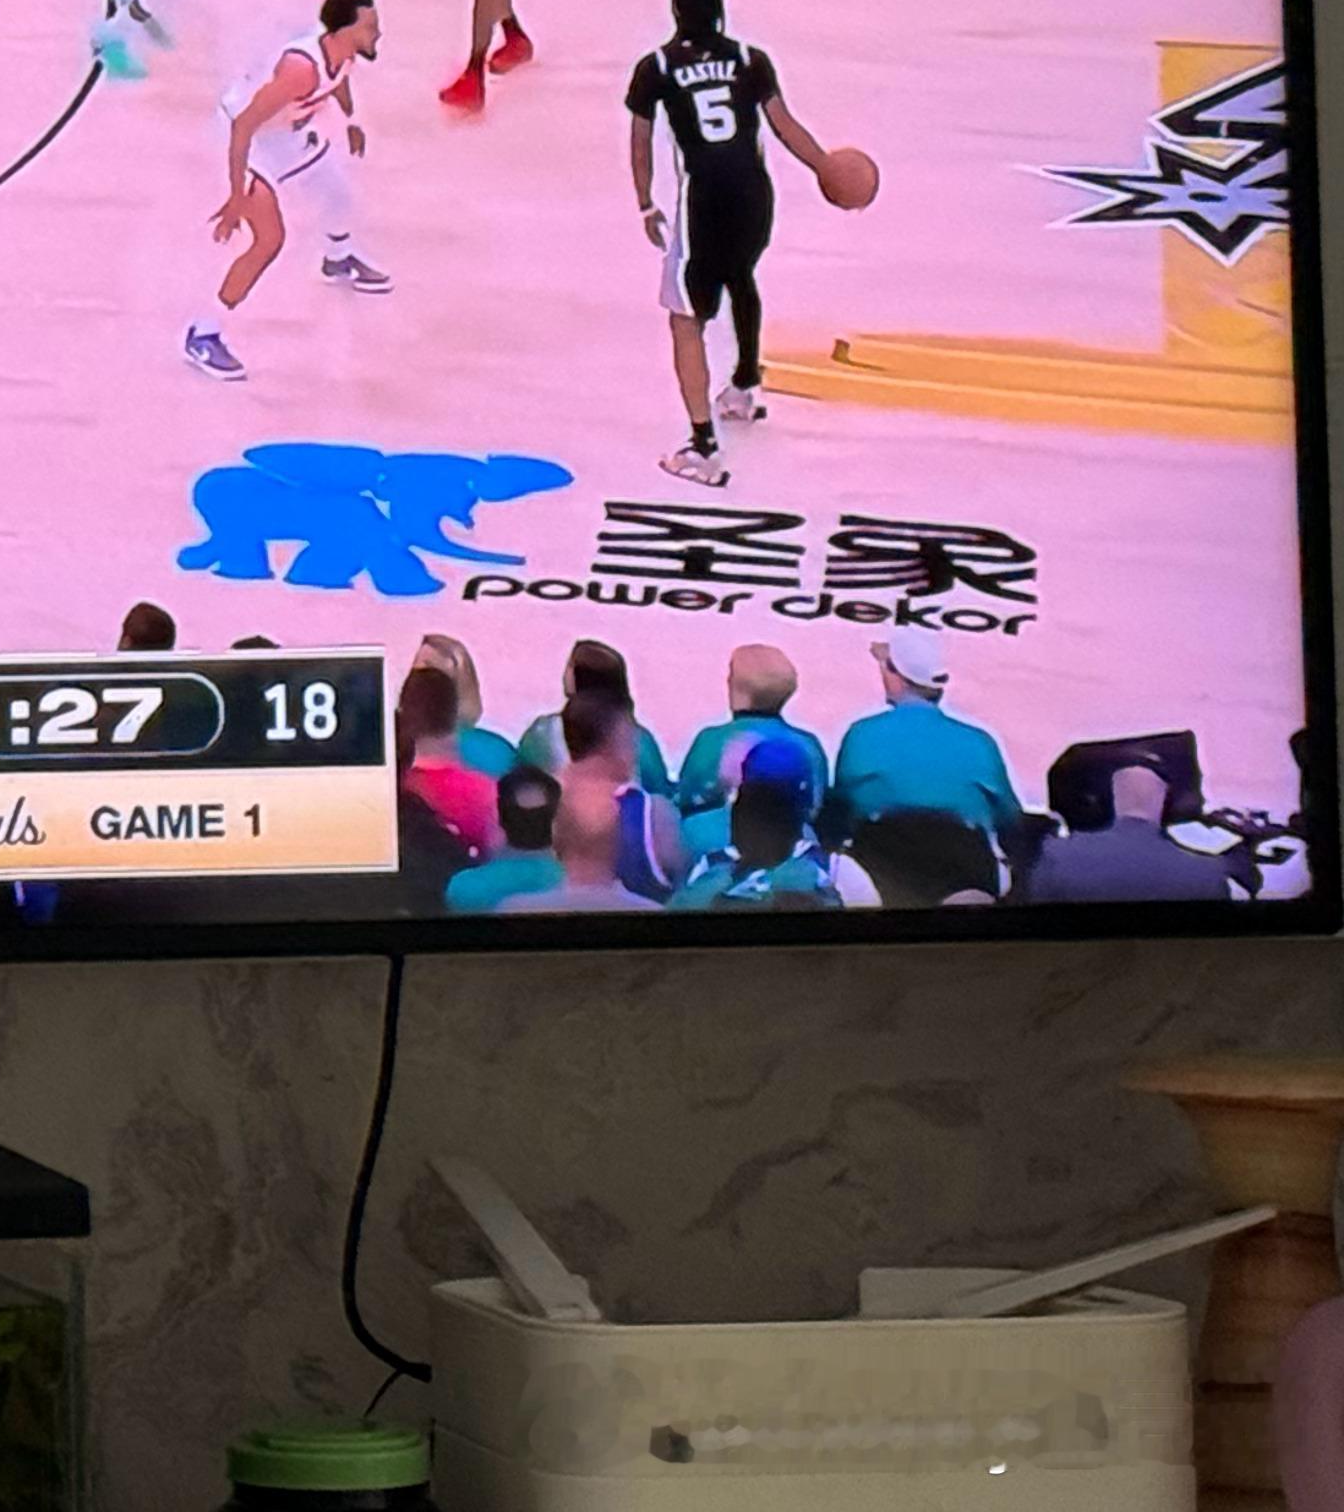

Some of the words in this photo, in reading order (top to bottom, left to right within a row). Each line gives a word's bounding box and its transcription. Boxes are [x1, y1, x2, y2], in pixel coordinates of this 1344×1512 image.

[673, 60, 737, 88] CASTLE
[692, 85, 738, 143] 5
[590, 499, 1038, 605] 圣象
[462, 573, 754, 615] power
[771, 590, 1039, 636] dekor
[264, 683, 339, 742] 18
[89, 803, 226, 841] GAME
[242, 803, 264, 839] 1
